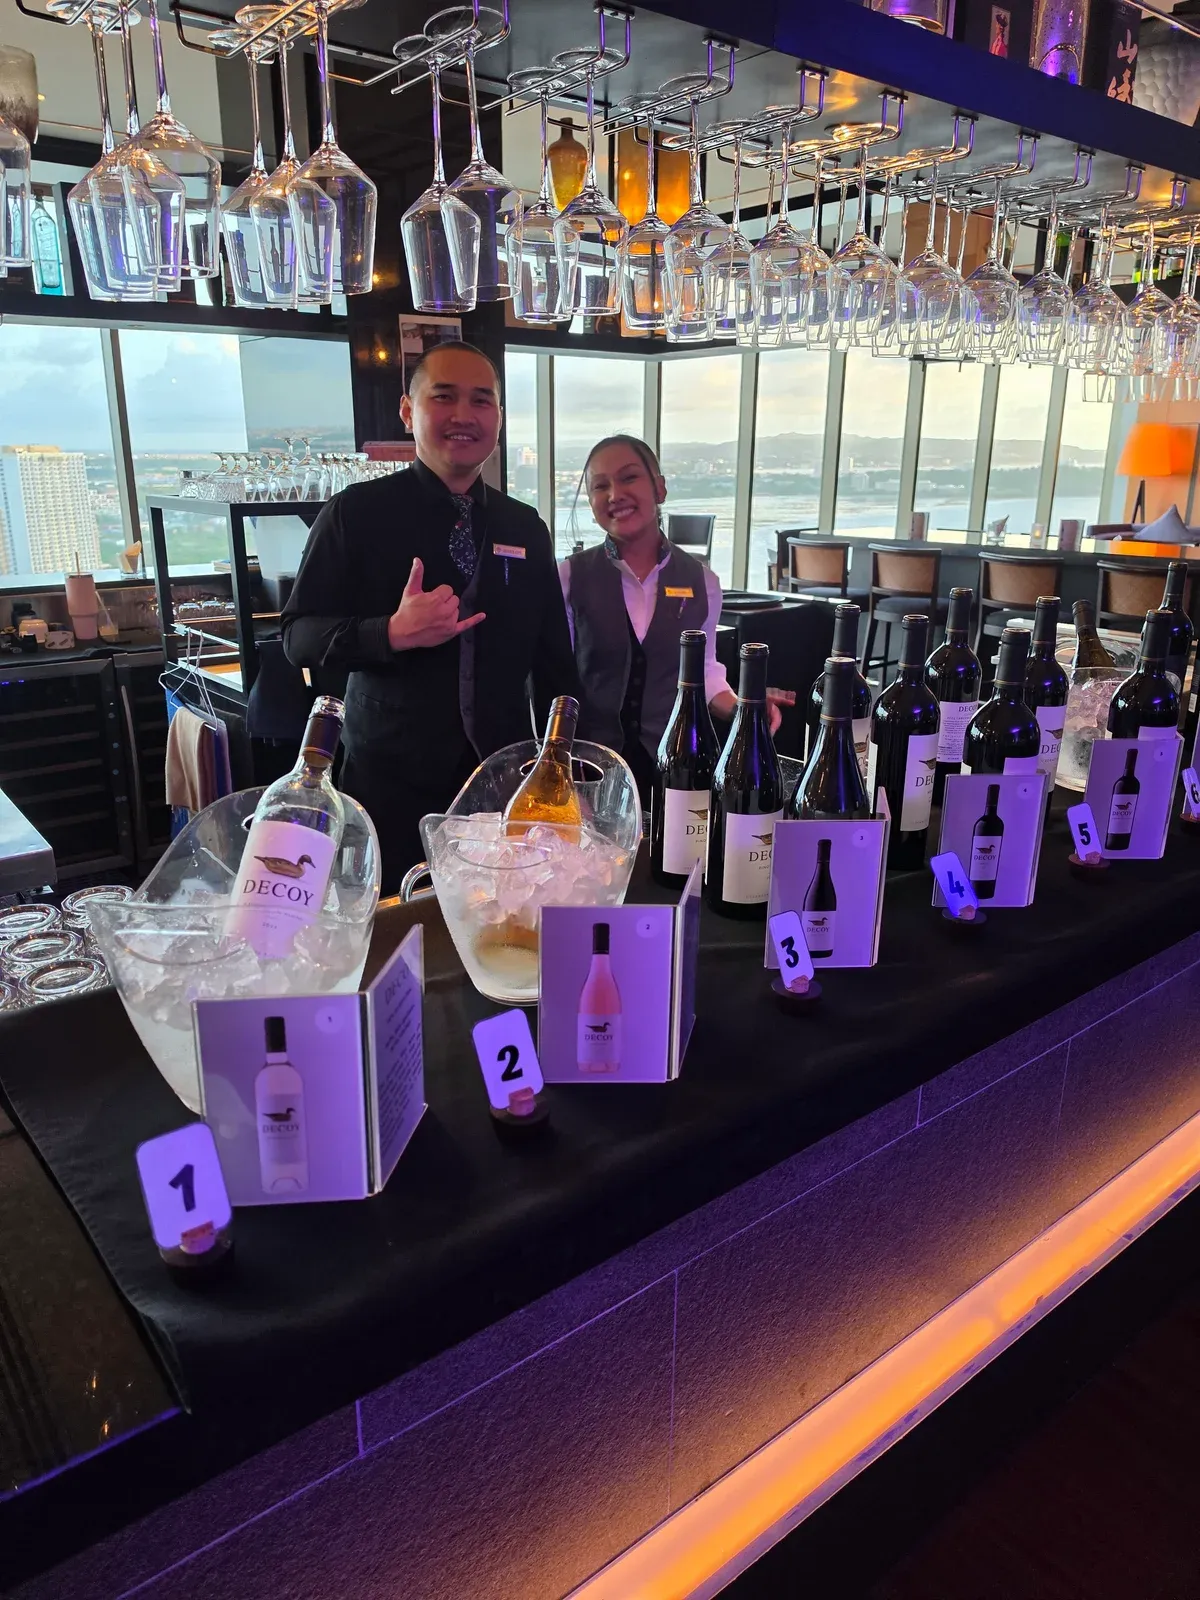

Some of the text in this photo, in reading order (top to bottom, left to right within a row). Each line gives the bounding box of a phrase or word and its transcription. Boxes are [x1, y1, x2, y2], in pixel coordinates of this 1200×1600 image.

[1191, 783, 1200, 804] 6
[1078, 822, 1091, 846] 5
[243, 879, 315, 907] DECOY
[947, 871, 965, 898] 4
[780, 936, 799, 968] 3
[497, 1044, 523, 1082] 2
[262, 1124, 299, 1134] DECOY
[168, 1163, 196, 1213] 1
